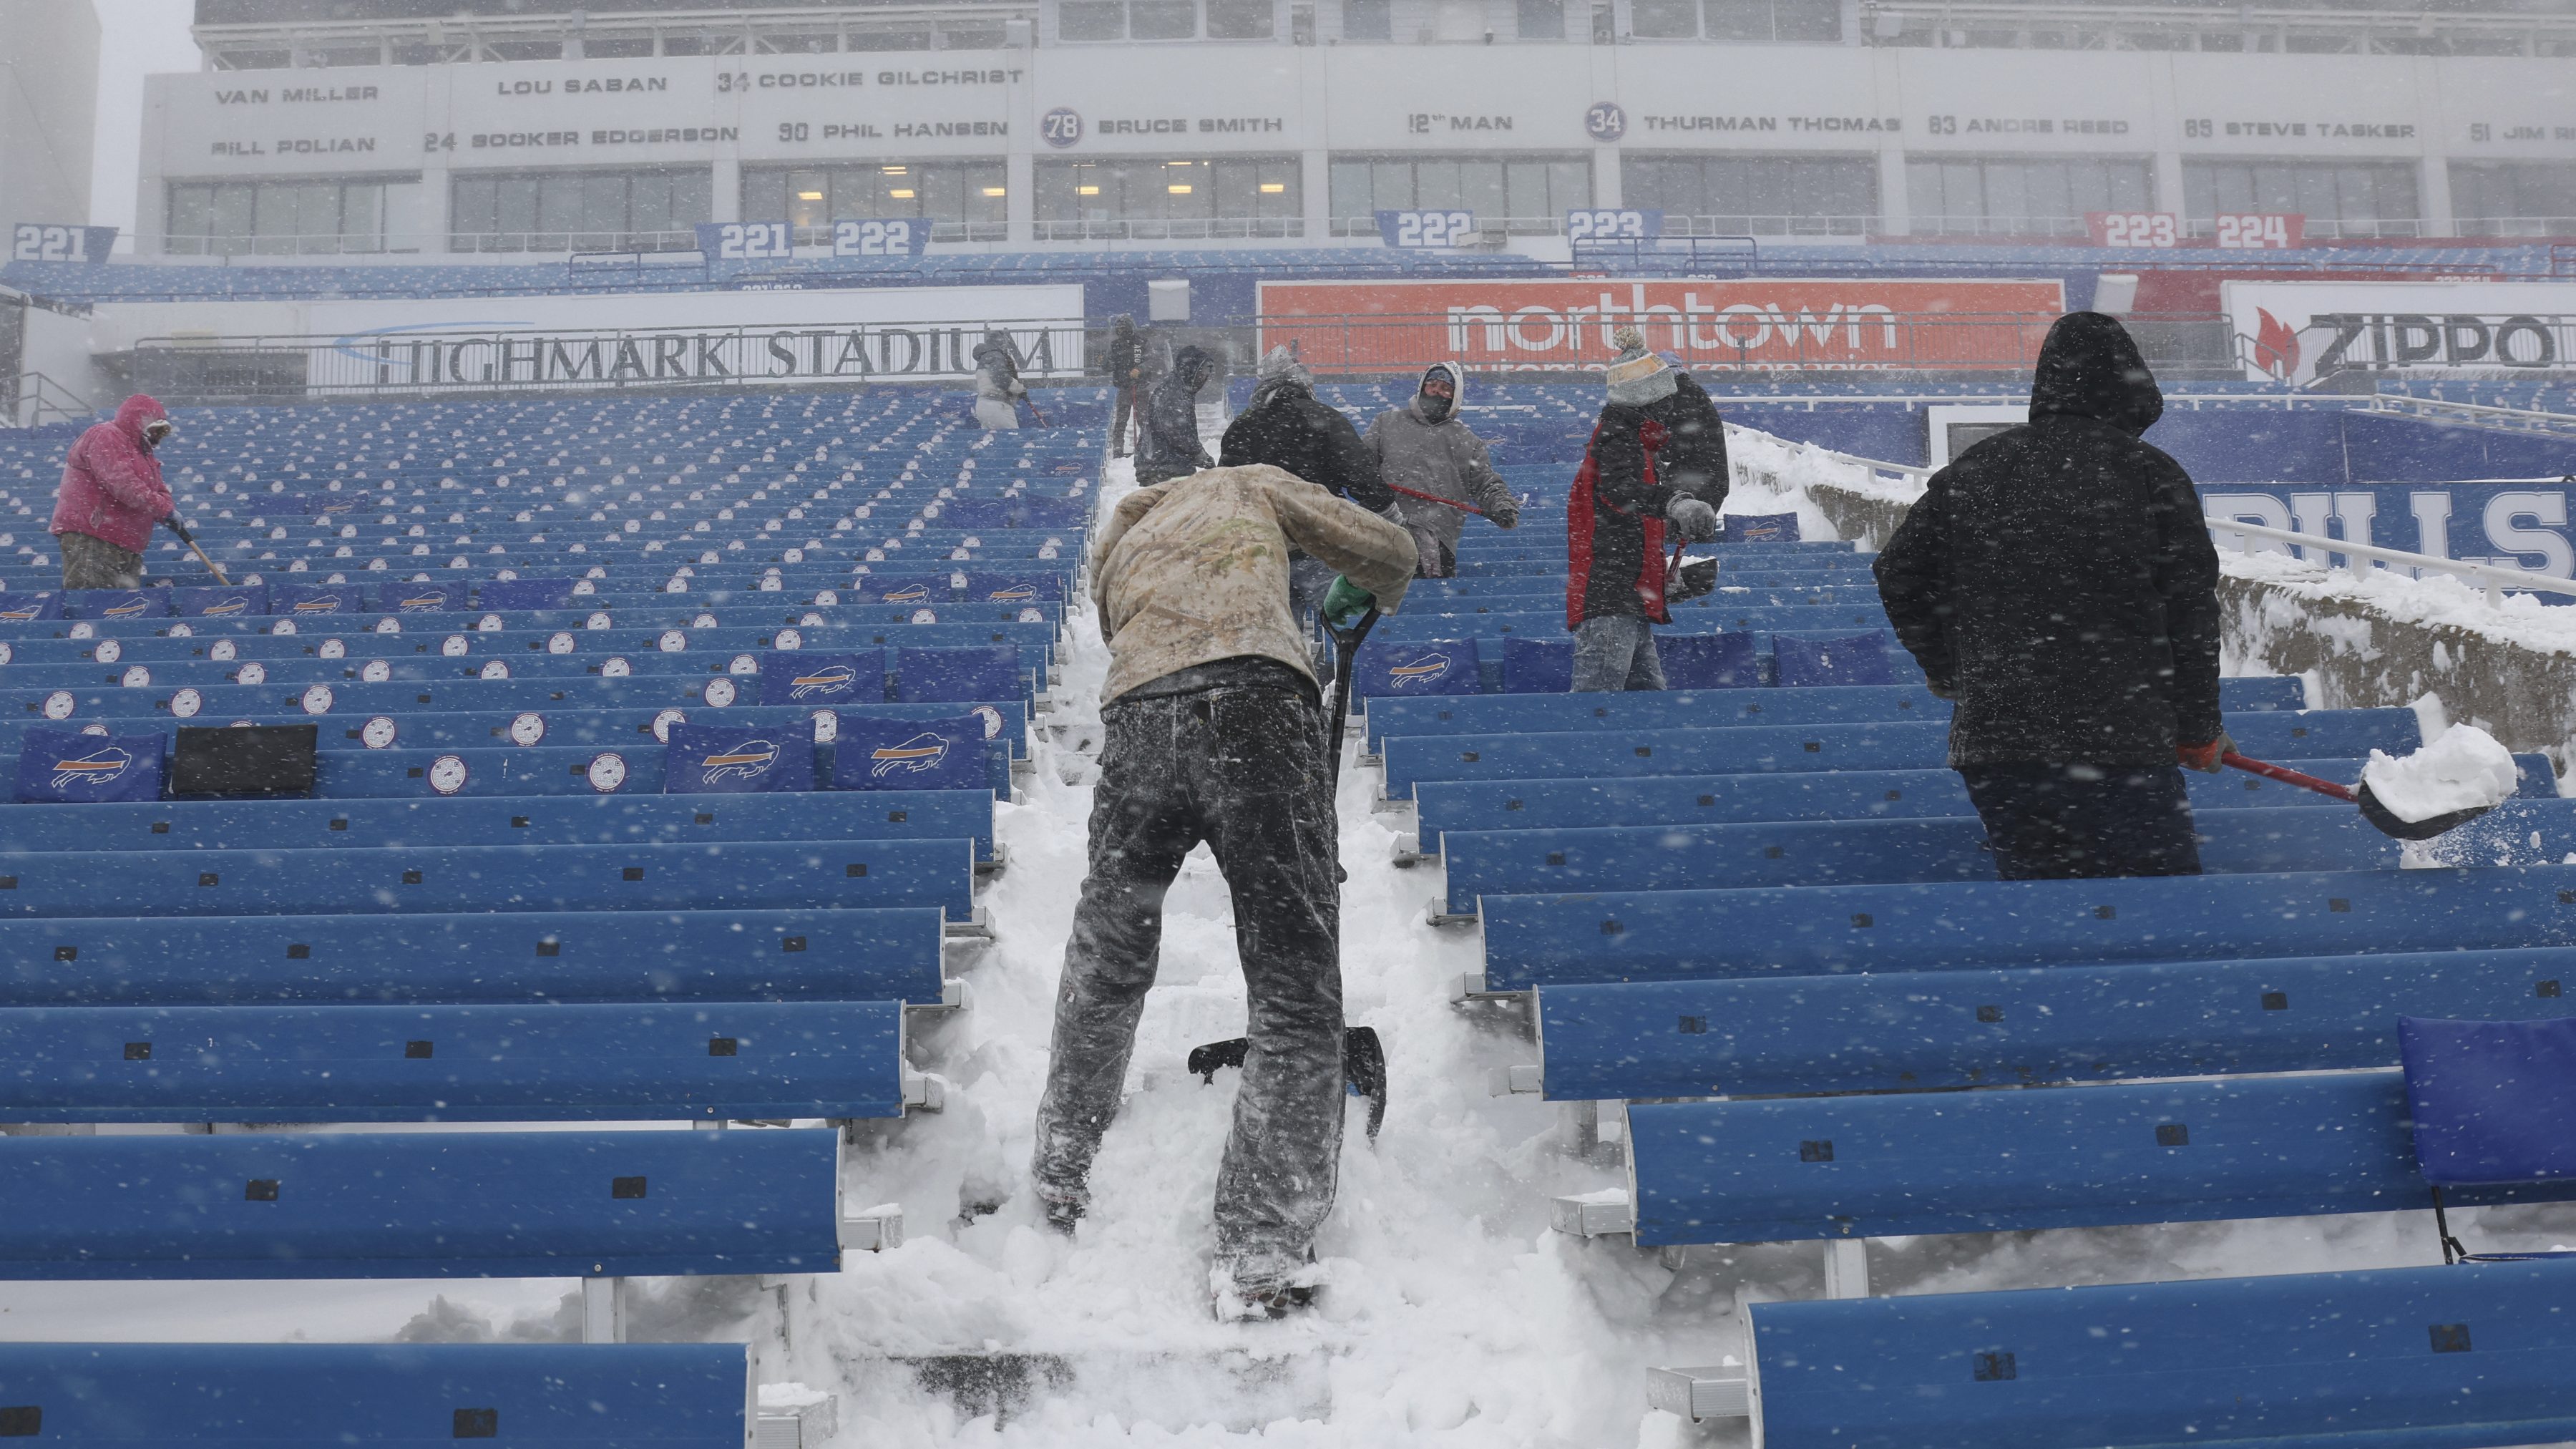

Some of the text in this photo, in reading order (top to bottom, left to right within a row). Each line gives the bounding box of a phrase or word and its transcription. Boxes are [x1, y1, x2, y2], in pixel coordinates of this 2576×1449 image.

[497, 77, 667, 94] LOU SABAN
[718, 69, 1023, 92] 34 COOKIE GILCHRIST
[215, 86, 379, 104] VAN MILLER
[779, 122, 1008, 142] 90 PHIL HANSEN
[1047, 114, 1283, 138] 78 BRUCE SMITH
[1451, 116, 1513, 130] MAN
[1590, 109, 1902, 133] 34 THURMAN THOMAS
[1929, 115, 2129, 135] 83 ANDRE REED
[2185, 119, 2416, 138] 89 STEVE TASKER
[2470, 123, 2491, 142] 51
[2503, 126, 2545, 140] JIM
[212, 137, 375, 155] BILL POLIAN
[424, 127, 738, 152] 24 BOOKER EDGERSON
[836, 220, 909, 255] 222
[1398, 213, 1471, 246] 222
[1570, 211, 1643, 245] 223
[2105, 214, 2176, 248] 223
[2218, 215, 2288, 248] 224
[15, 225, 89, 263] 221
[721, 223, 790, 258] 221
[1448, 283, 1897, 352] northtown
[2311, 313, 2555, 369] ZIPPO
[379, 326, 1055, 384] HIGHMARK STADIUM
